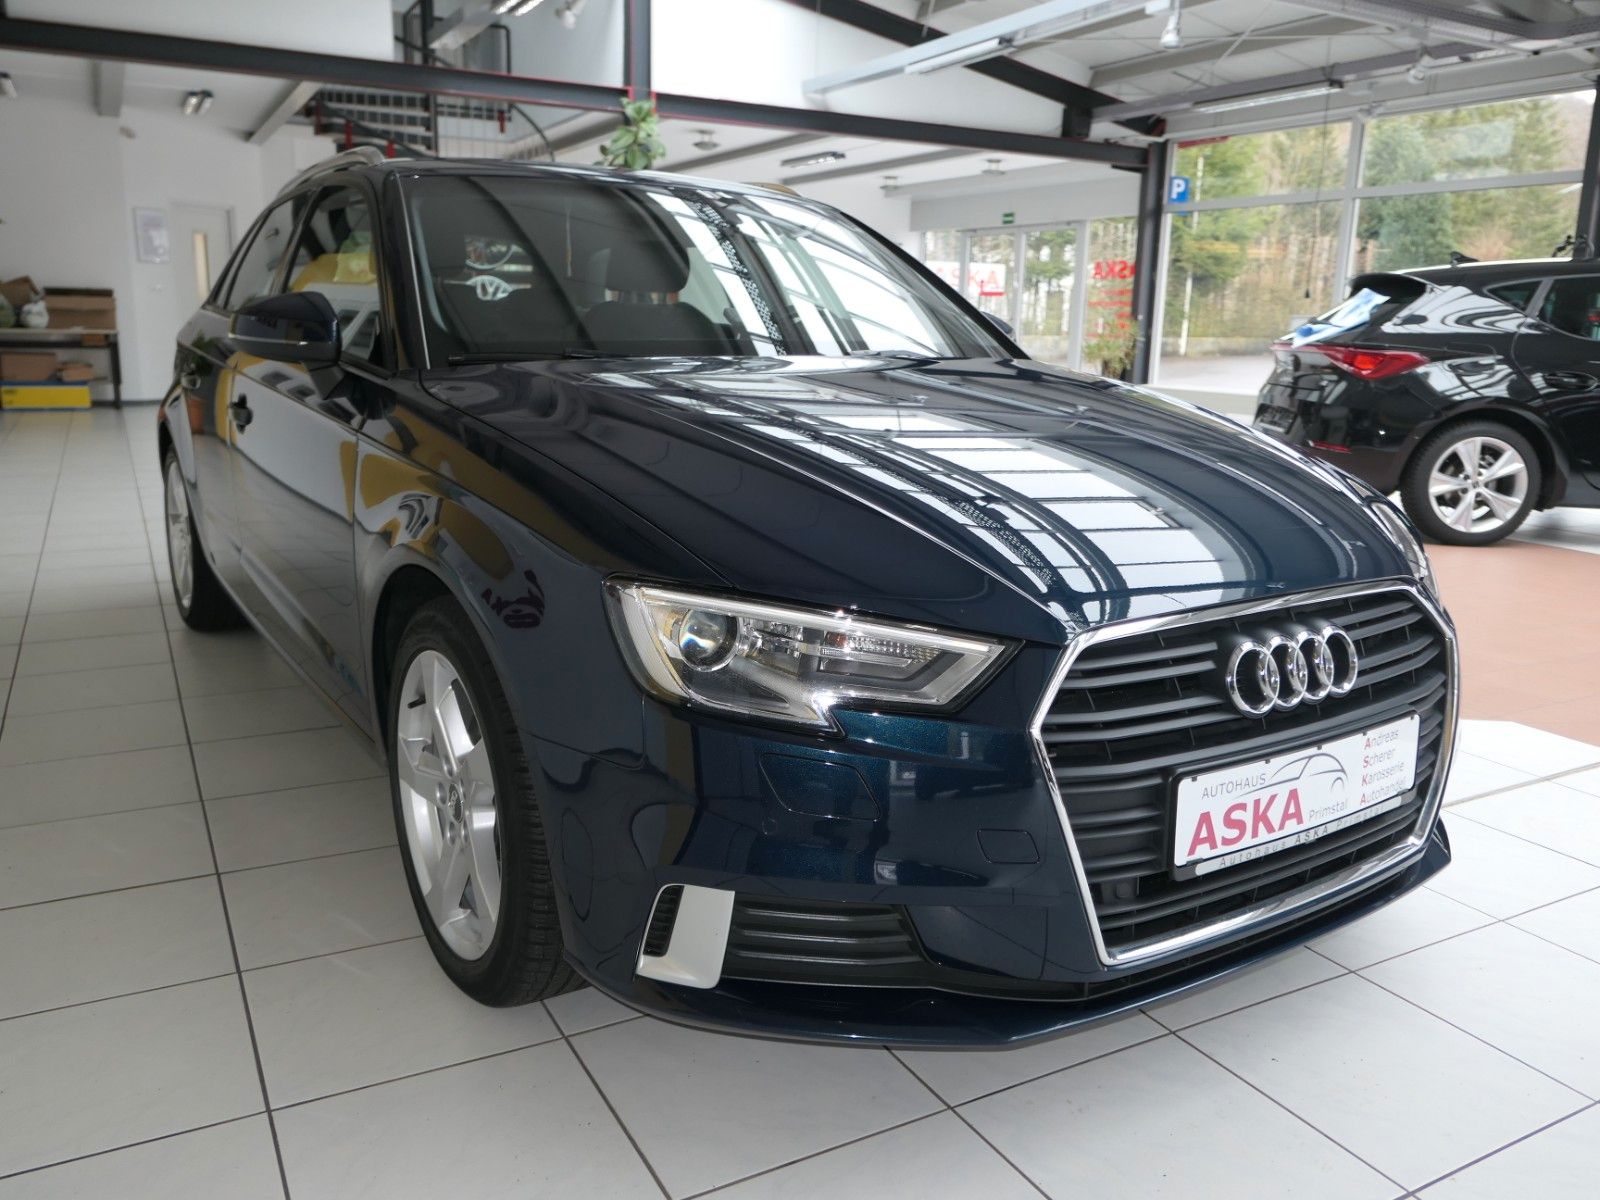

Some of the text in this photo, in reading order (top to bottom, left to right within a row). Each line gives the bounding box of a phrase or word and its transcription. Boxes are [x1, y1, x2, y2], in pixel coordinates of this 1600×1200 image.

[1171, 178, 1186, 199] P
[1364, 730, 1399, 750] Andreas
[1363, 748, 1396, 768] Scherer
[1201, 773, 1267, 800] AUTOHAUS
[1187, 788, 1304, 857] ASKA
[1309, 797, 1349, 823] Primstal
[1219, 840, 1287, 868] Autohaus
[1295, 827, 1329, 845] ASKA
